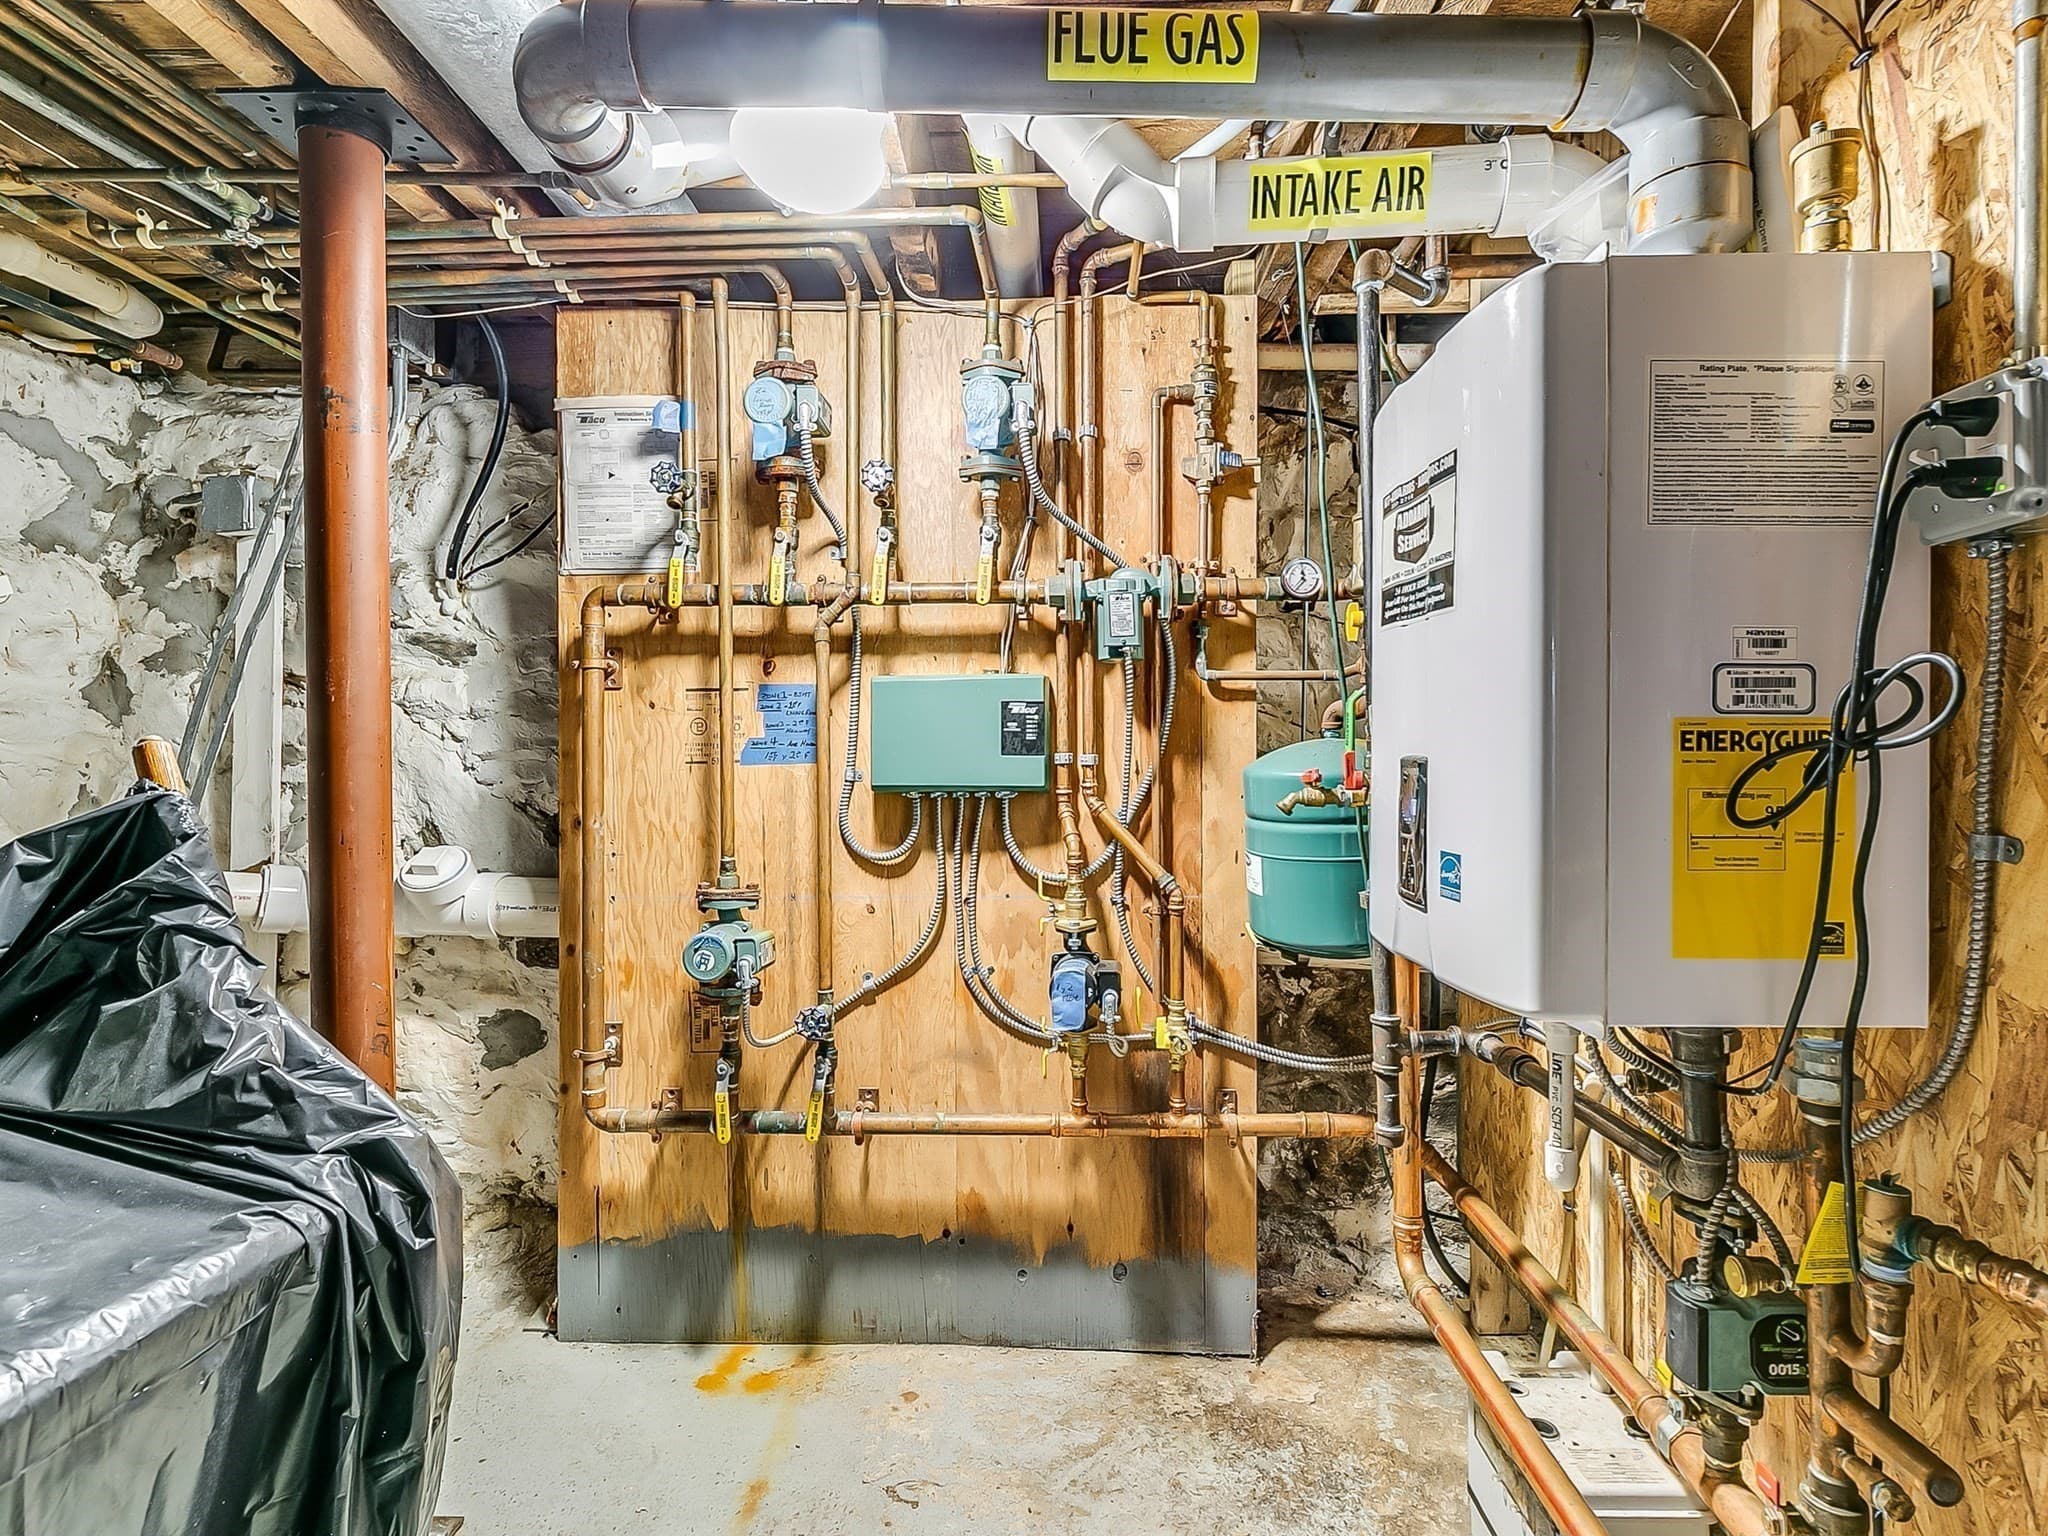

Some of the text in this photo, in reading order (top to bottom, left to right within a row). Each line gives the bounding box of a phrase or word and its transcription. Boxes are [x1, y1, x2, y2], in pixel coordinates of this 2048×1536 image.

[1054, 11, 1245, 65] FLUE GAS
[1251, 165, 1426, 220] INTAKE AIR
[1699, 365, 1725, 374] Rating
[1680, 729, 1833, 755] ENERGYGUI
[1552, 1106, 1562, 1130] SCH
